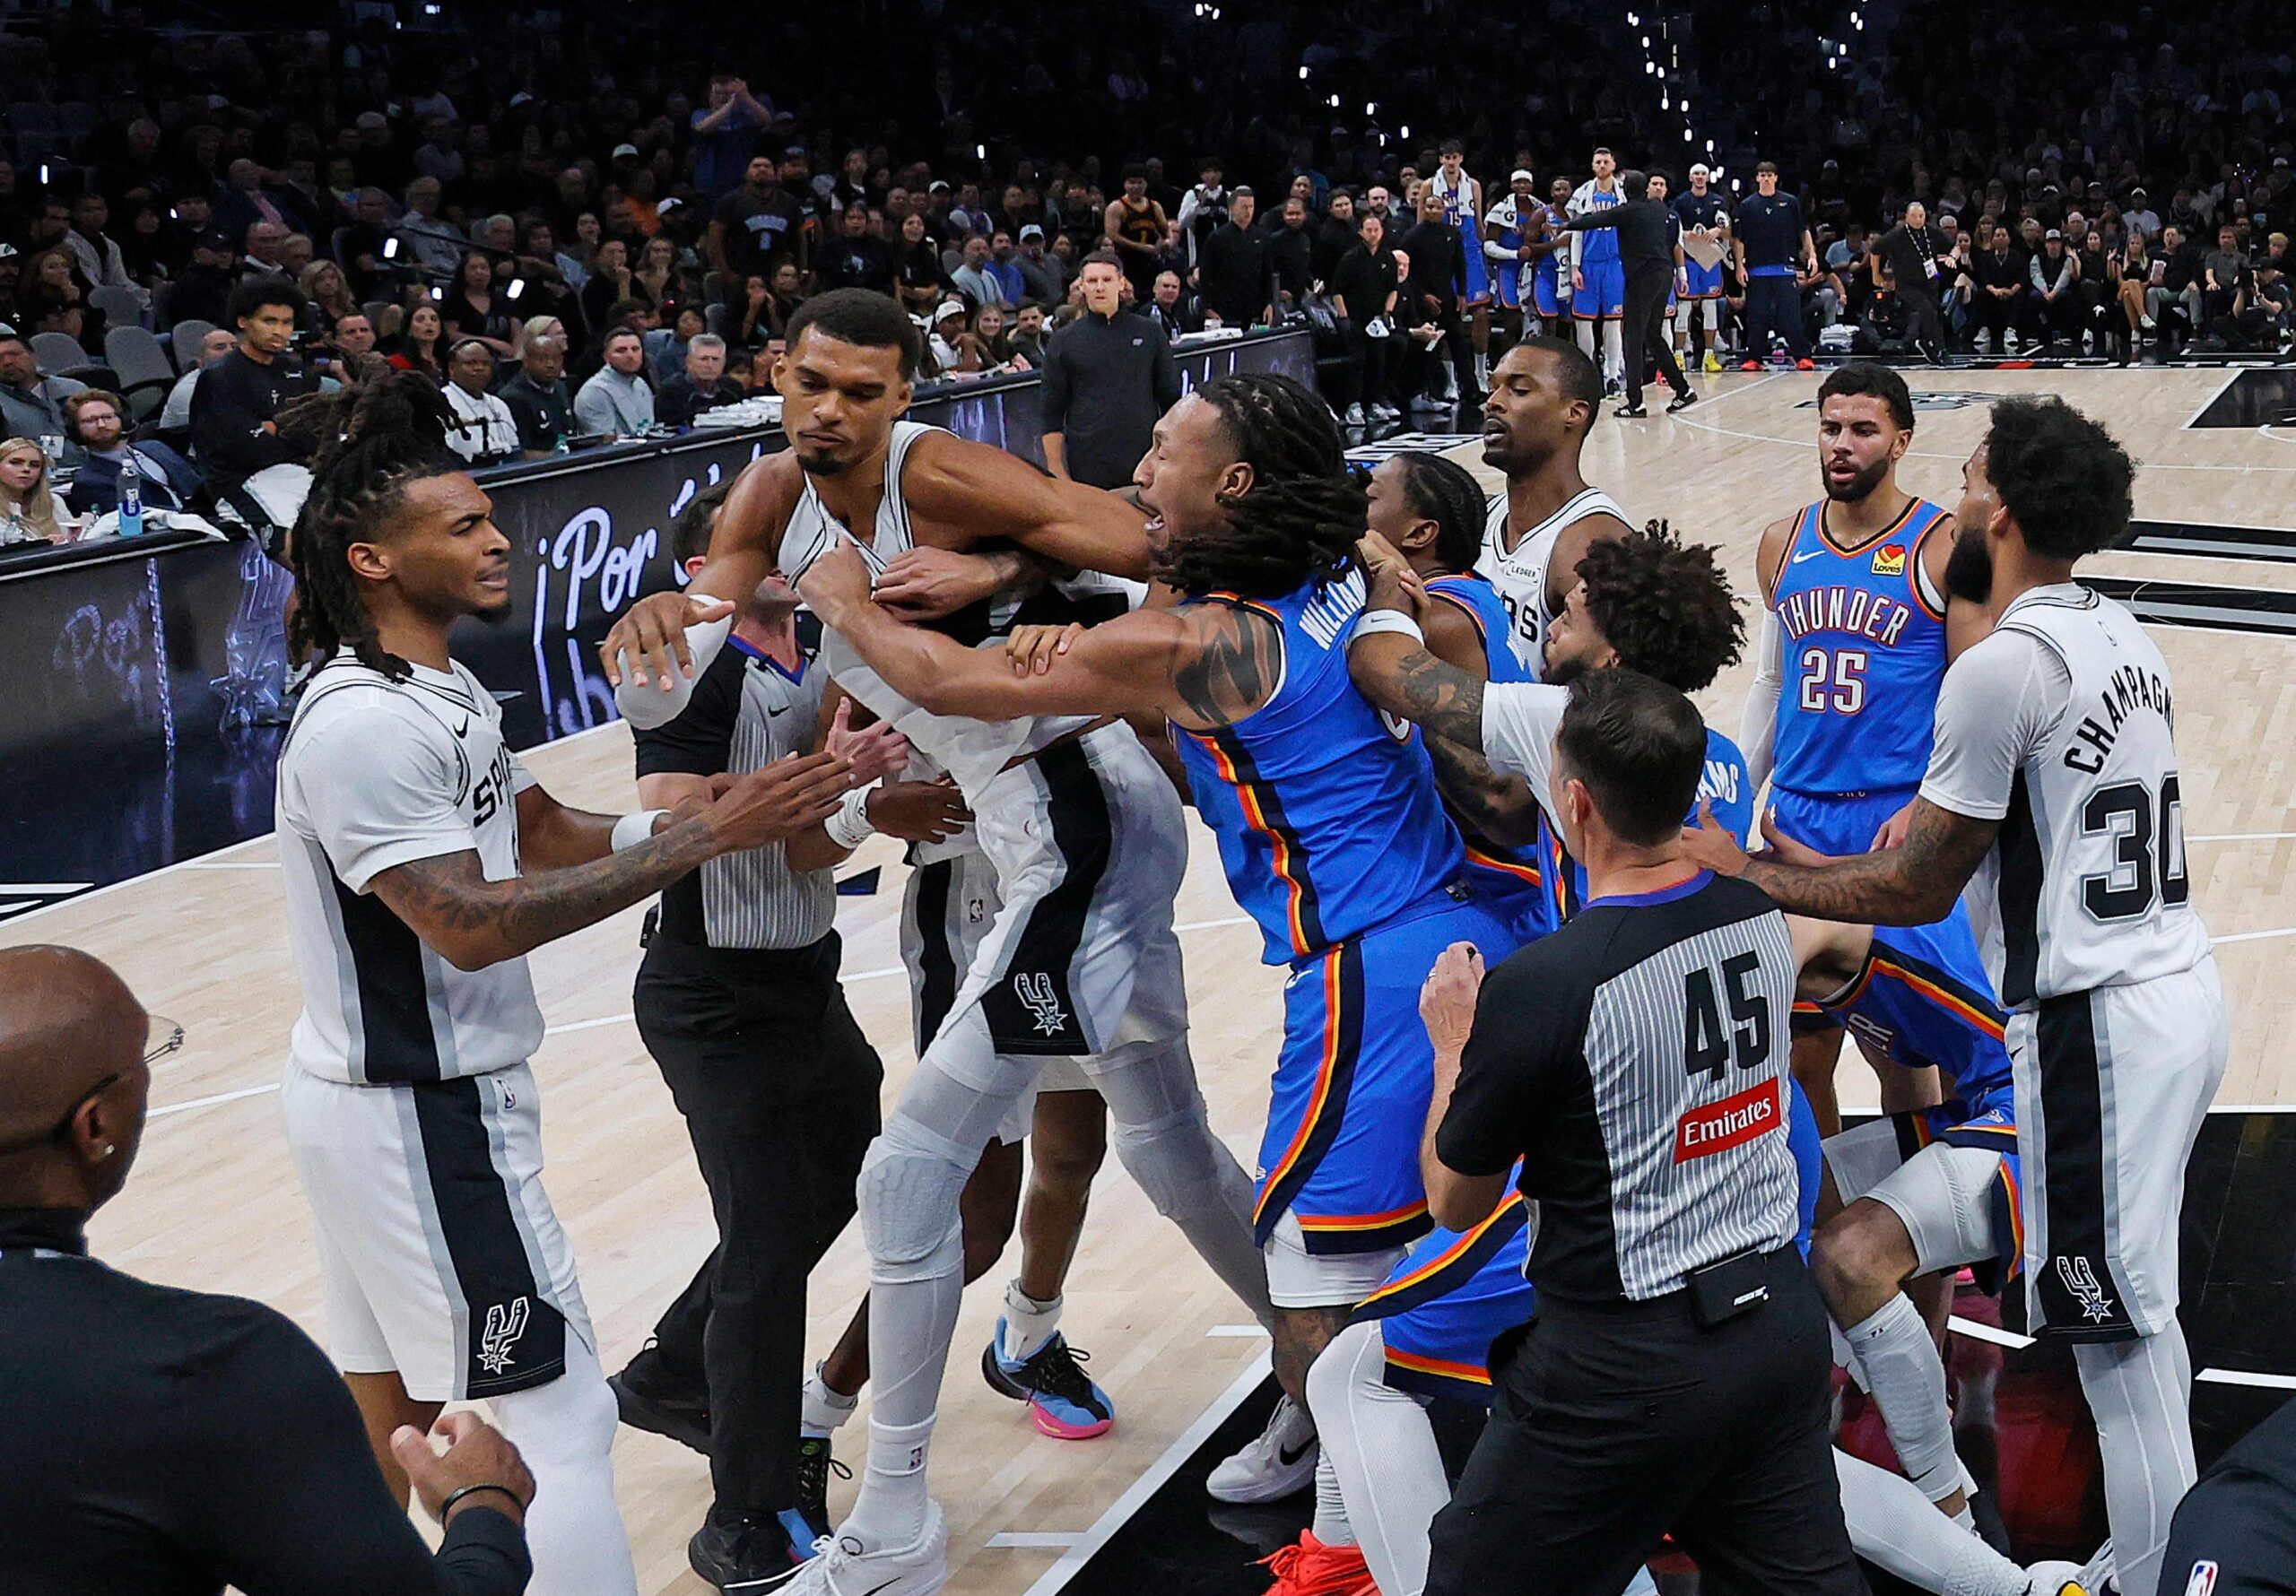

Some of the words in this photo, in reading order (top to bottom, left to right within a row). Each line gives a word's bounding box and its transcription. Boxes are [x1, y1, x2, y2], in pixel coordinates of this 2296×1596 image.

[1448, 211, 1464, 227] 15
[1510, 564, 1537, 578] LEDGER
[1298, 564, 1367, 652] WILLIAM
[1776, 587, 1912, 647] THUNDER
[1799, 647, 1867, 716] 25
[2064, 664, 2176, 776] CHAMPAGN
[2078, 771, 2191, 927] 30
[1685, 950, 1770, 1083] 45
[1684, 1097, 1772, 1147] Emirates
